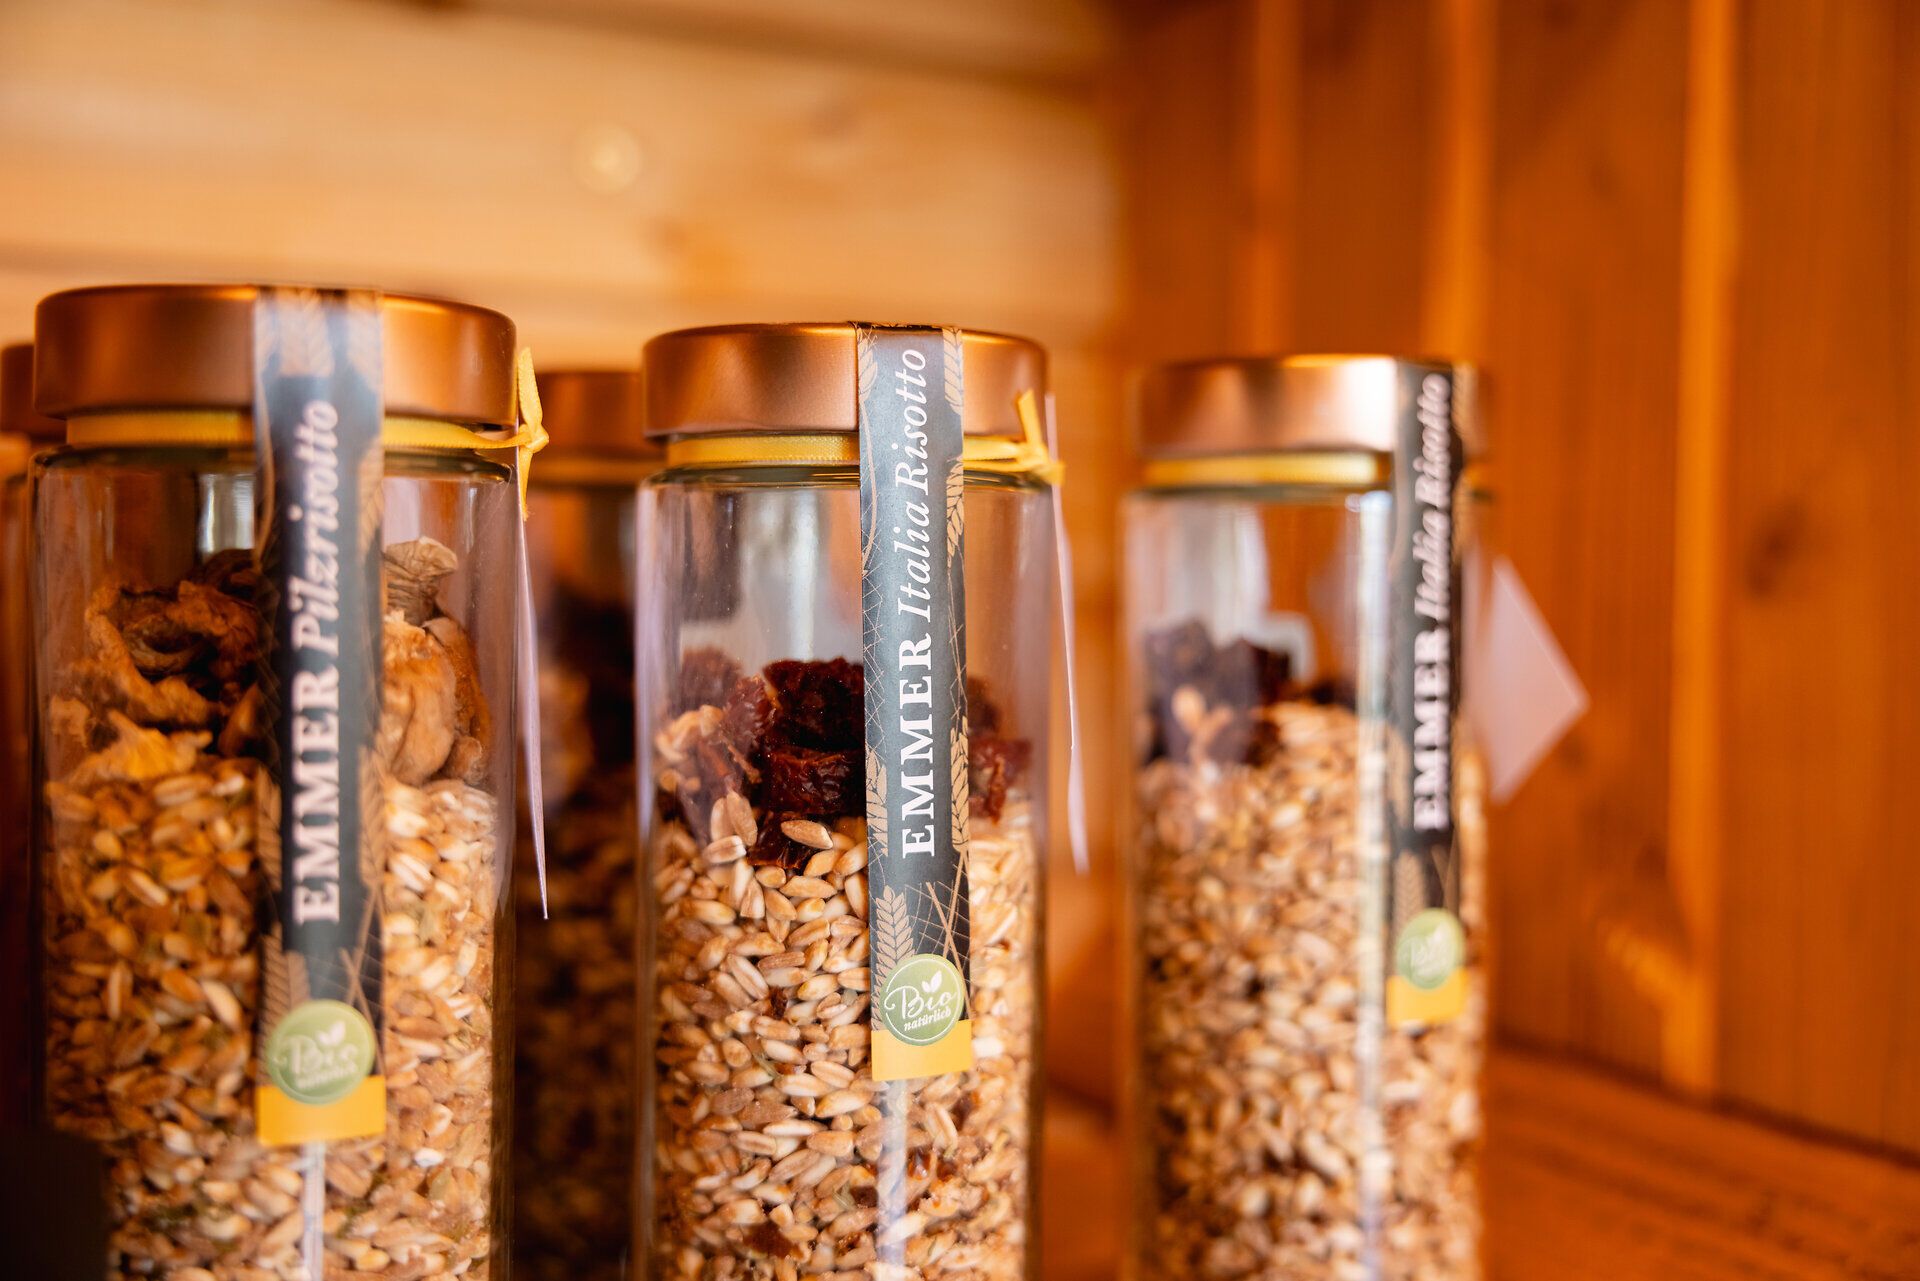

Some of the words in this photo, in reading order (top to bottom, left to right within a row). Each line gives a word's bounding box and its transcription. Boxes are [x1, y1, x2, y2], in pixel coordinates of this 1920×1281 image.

[891, 348, 929, 496] Risotto
[1412, 373, 1450, 509] Risotto
[288, 400, 340, 658] Pilzrisotto
[894, 500, 931, 623] Italia
[1412, 509, 1450, 621] Italia
[292, 663, 340, 924] EMMER
[899, 632, 935, 859] EMMER
[1414, 624, 1449, 833] EMMER
[884, 985, 957, 1020] Bio
[904, 1005, 952, 1031] natürlich
